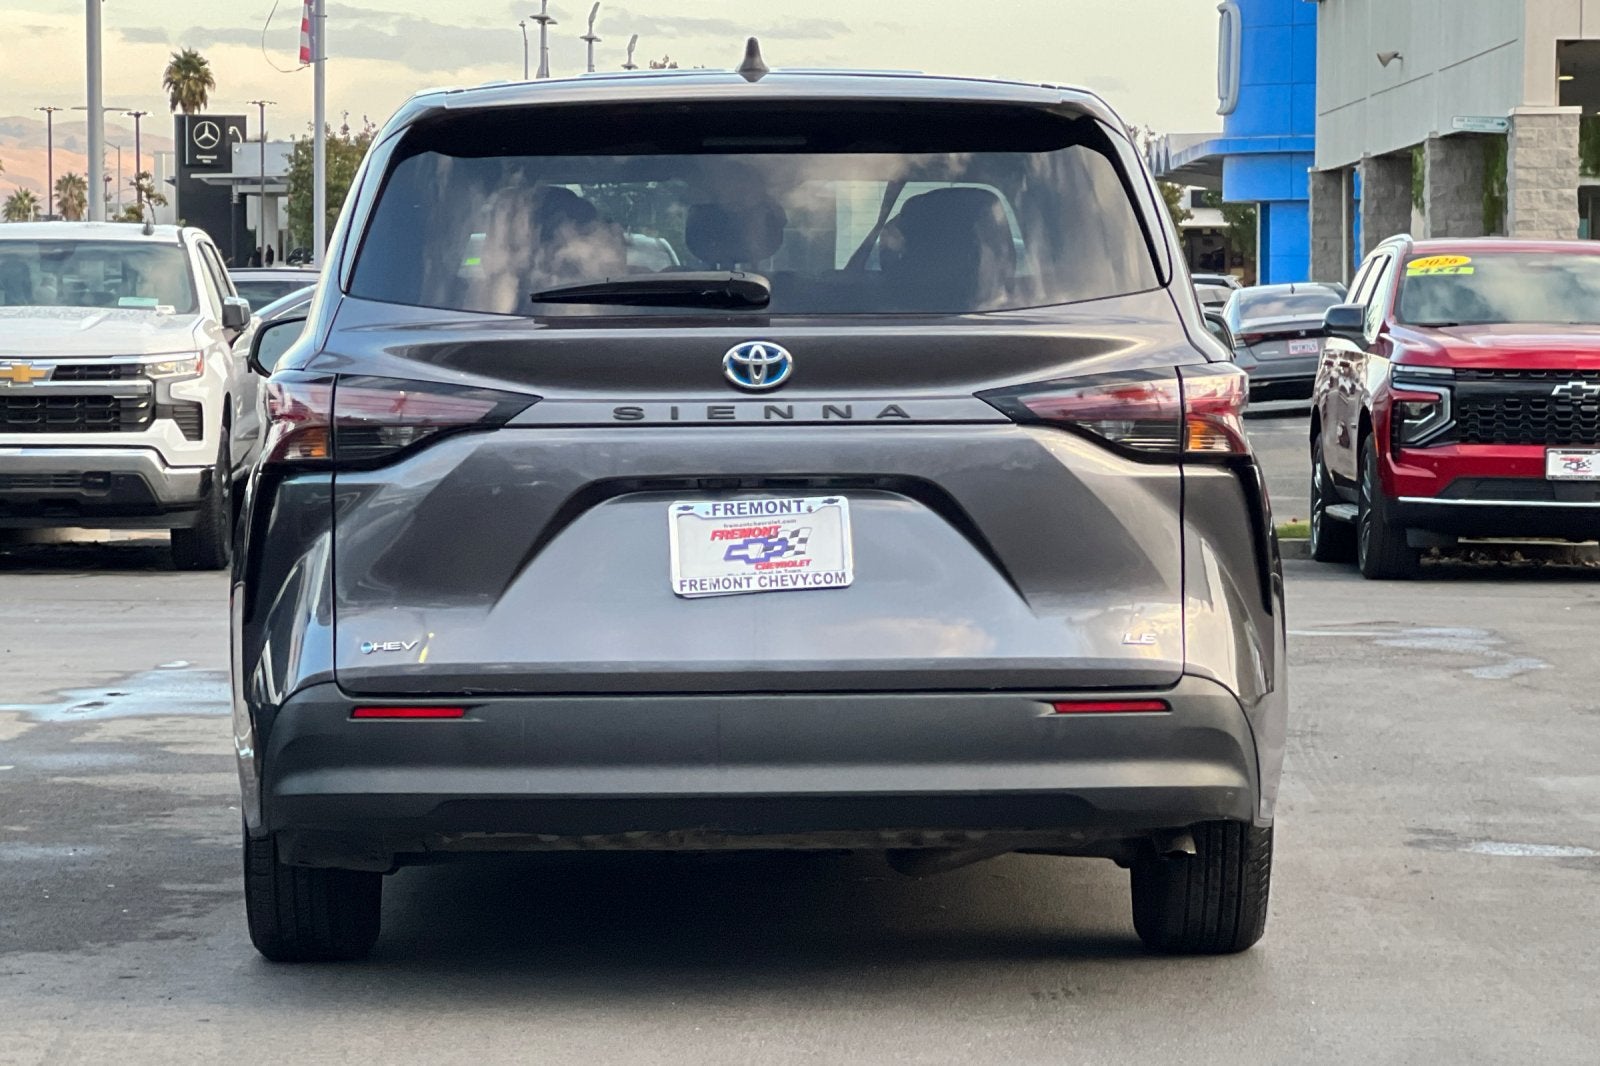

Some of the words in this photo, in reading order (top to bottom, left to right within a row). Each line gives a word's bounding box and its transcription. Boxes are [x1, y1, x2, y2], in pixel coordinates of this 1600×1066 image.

[1419, 257, 1458, 267] 2026
[613, 403, 911, 421] SIENNA
[711, 500, 804, 516] FREMONT
[710, 525, 782, 541] FREMONT
[755, 559, 812, 570] CHEVROLET
[679, 576, 752, 592] FREMONT
[758, 571, 847, 588] CHEVY.COM
[373, 640, 418, 651] HEV
